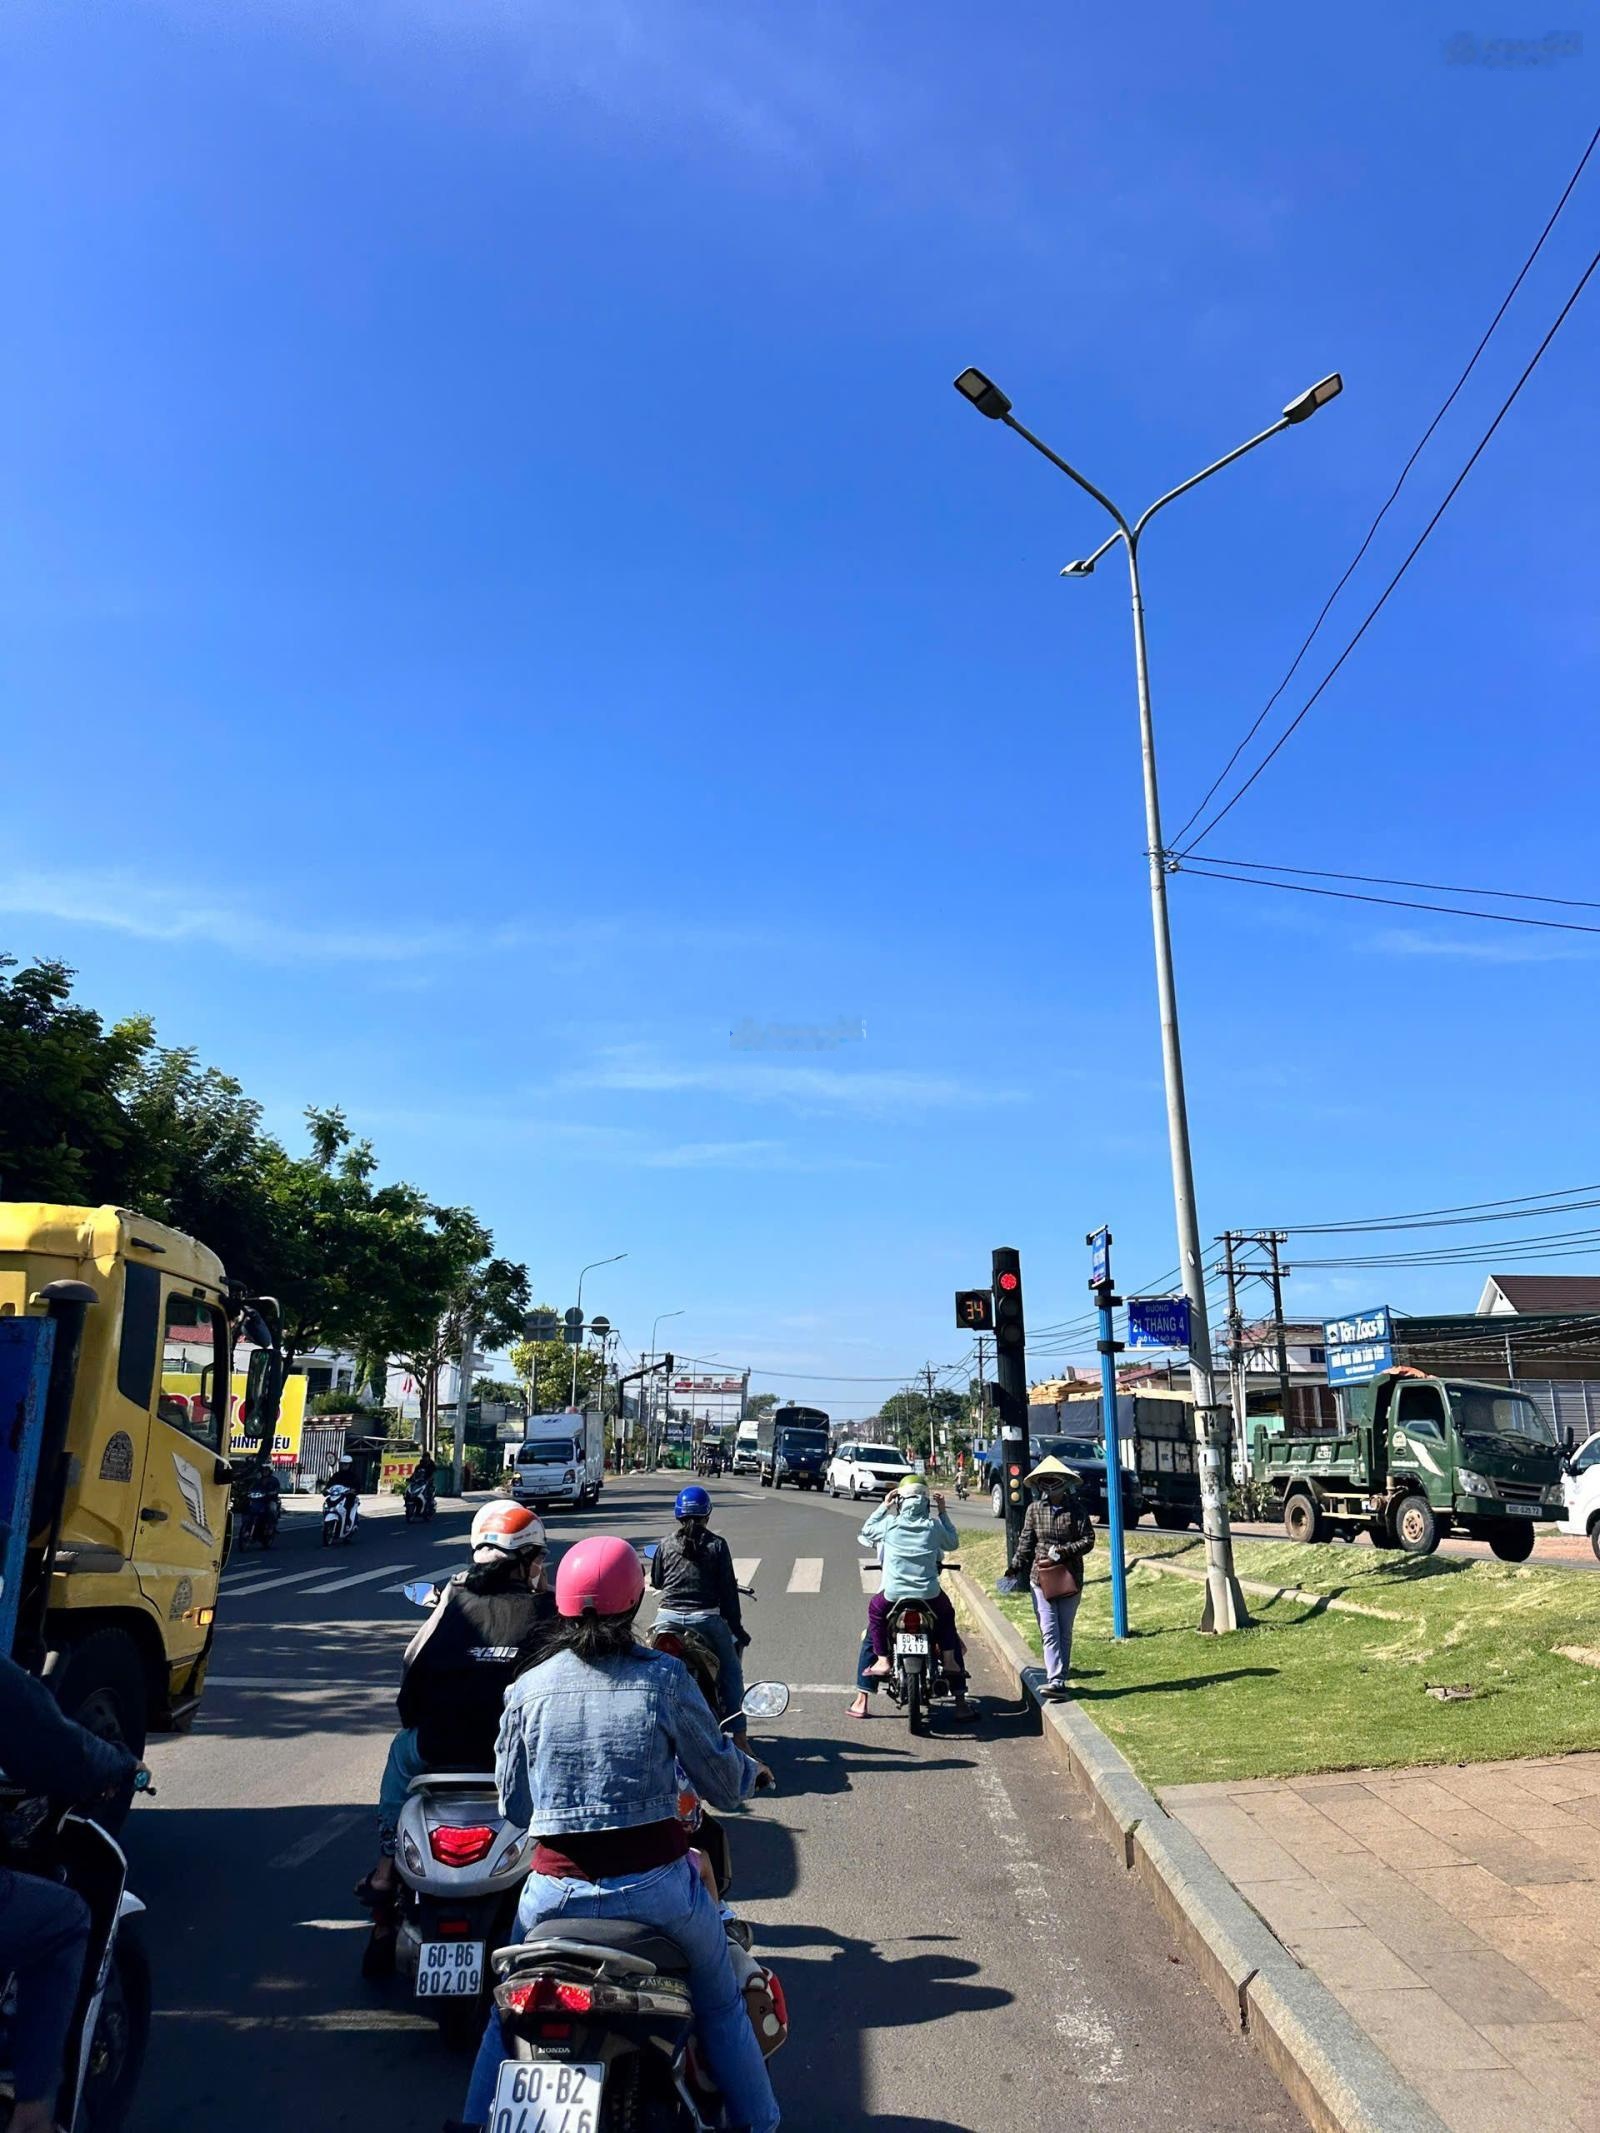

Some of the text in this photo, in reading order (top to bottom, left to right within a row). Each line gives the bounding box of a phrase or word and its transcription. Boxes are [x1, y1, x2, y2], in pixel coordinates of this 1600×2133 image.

[965, 1300, 984, 1320] 34
[1132, 1314, 1185, 1333] 21 THÁNG 4
[427, 1944, 474, 1968] 60-B6
[418, 1969, 479, 1994] 802.09
[512, 2067, 586, 2104] 60-B2
